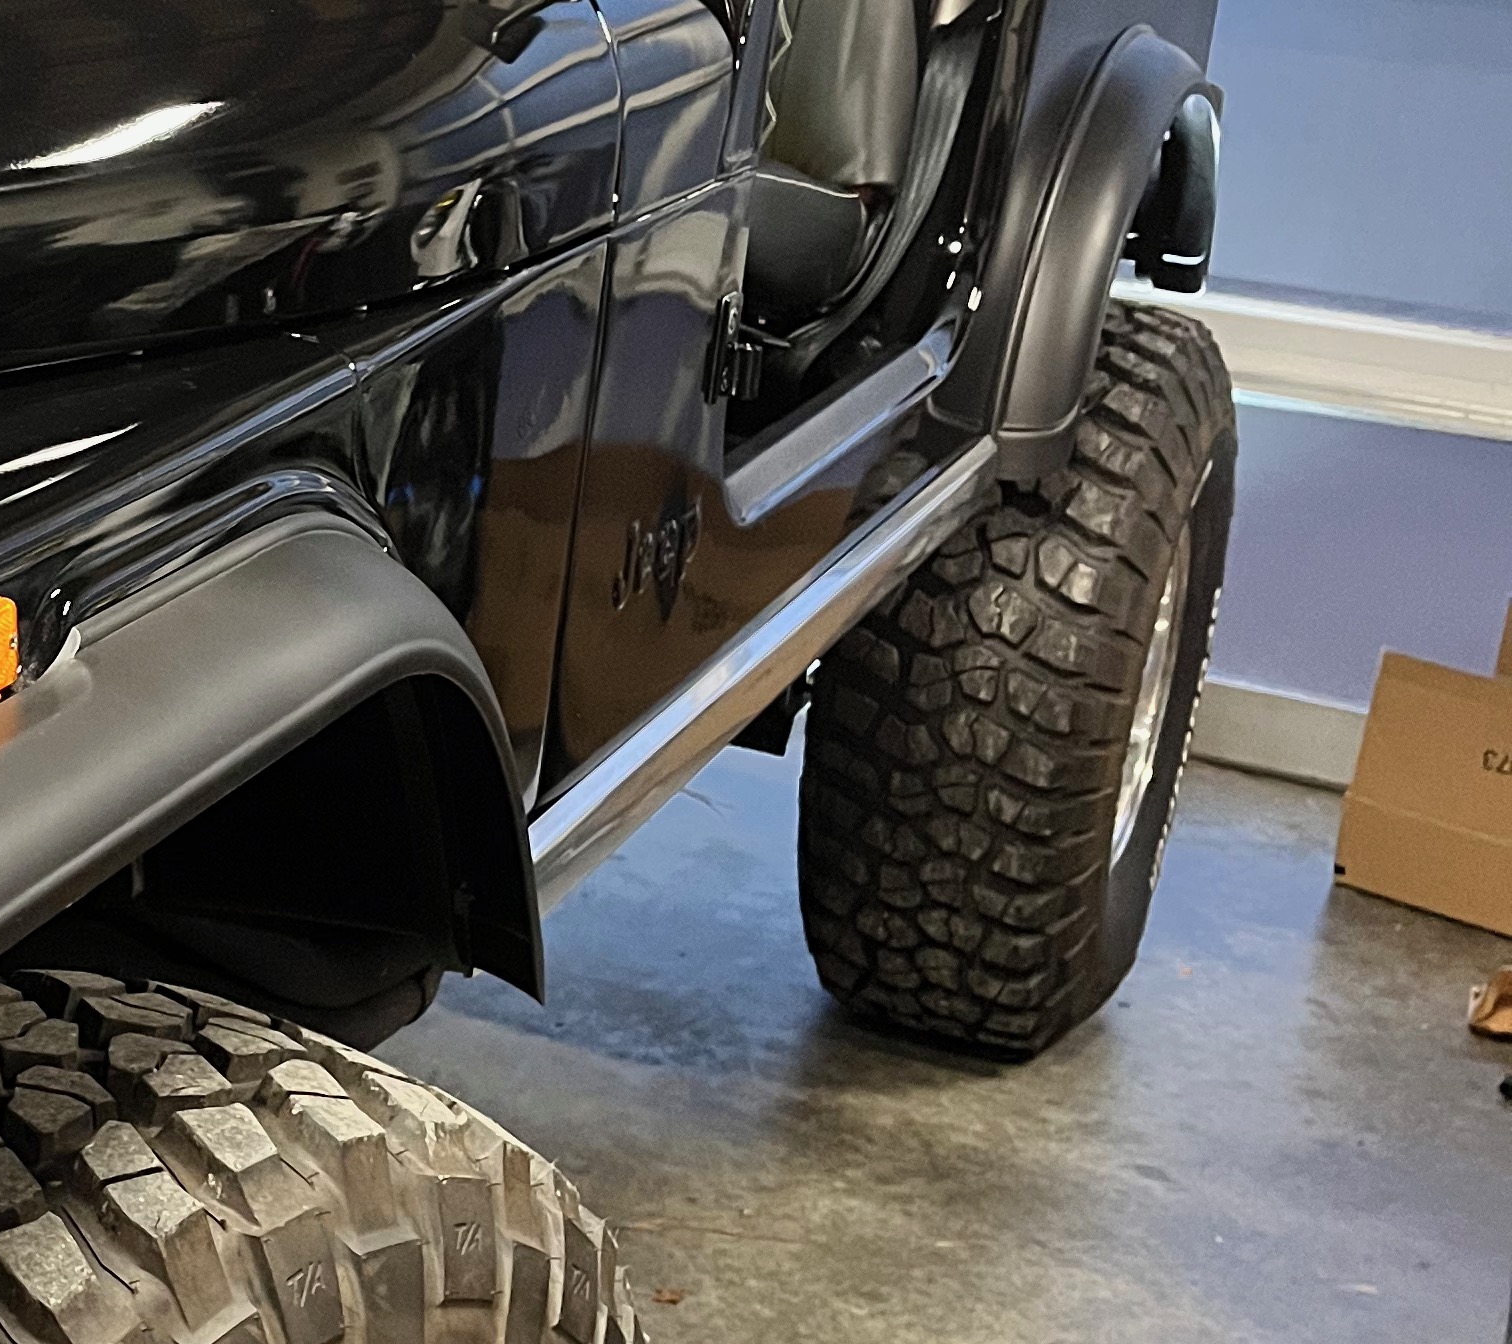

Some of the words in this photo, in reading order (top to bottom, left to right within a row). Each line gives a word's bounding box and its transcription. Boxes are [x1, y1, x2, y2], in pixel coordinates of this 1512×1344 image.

[1482, 748, 1512, 776] 73
[454, 1222, 484, 1256] T/A
[285, 1260, 328, 1308] T/A
